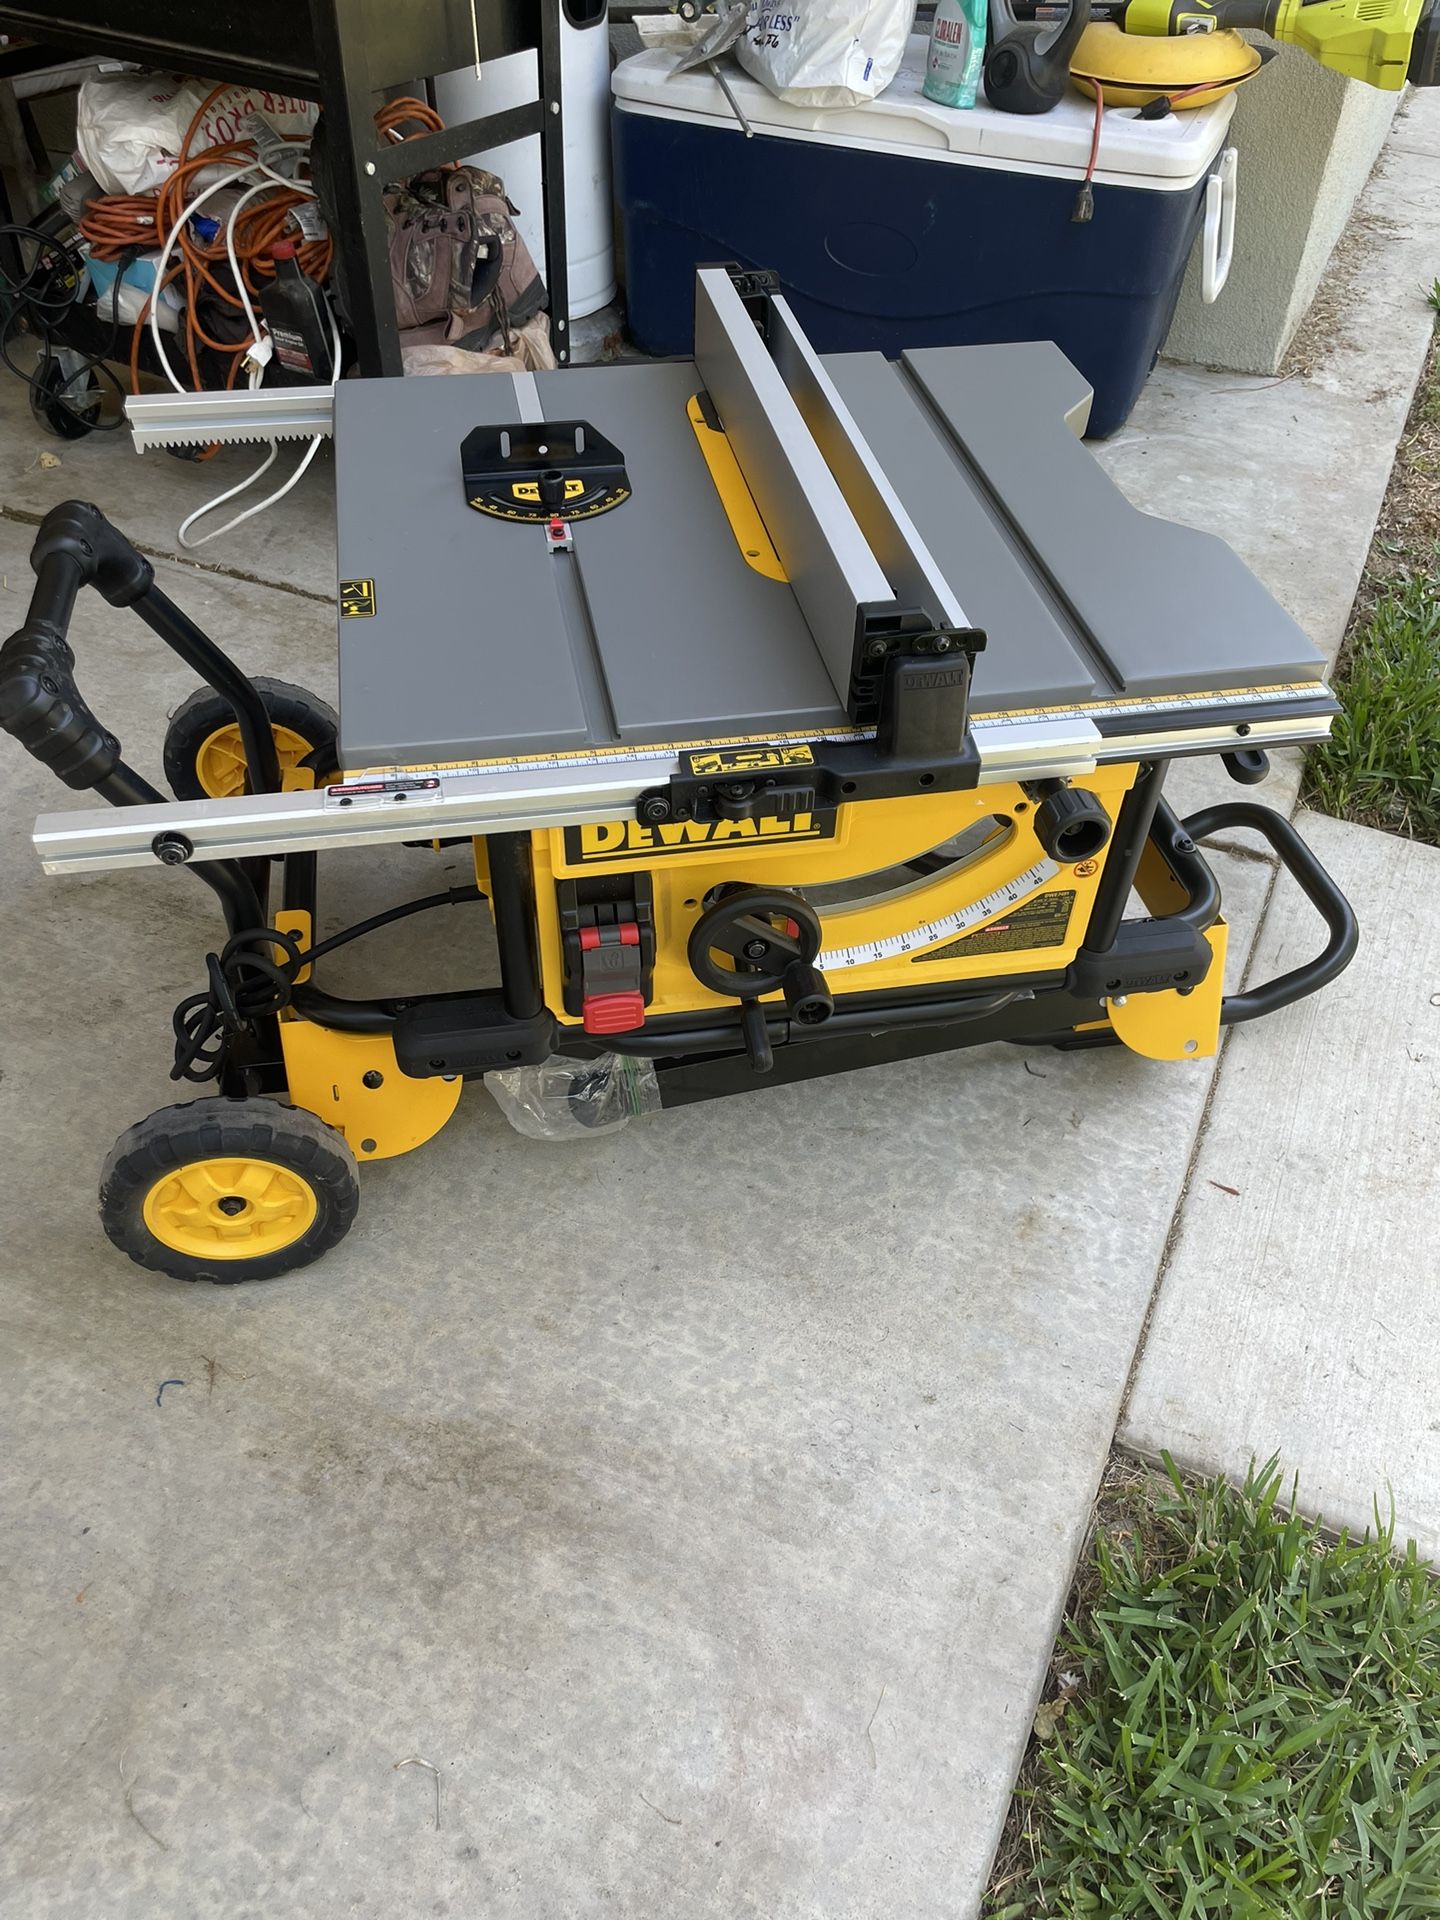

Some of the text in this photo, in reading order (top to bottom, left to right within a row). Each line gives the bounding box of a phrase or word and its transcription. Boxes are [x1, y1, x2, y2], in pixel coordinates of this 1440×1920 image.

[518, 483, 580, 495] DELT
[905, 669, 963, 689] DEWALT
[1033, 876, 1044, 885] 45
[1008, 893, 1018, 901] 40
[982, 908, 992, 916] 35
[956, 921, 966, 930] 30
[928, 933, 938, 941] 25
[901, 943, 911, 951] 20
[873, 951, 883, 959] 15
